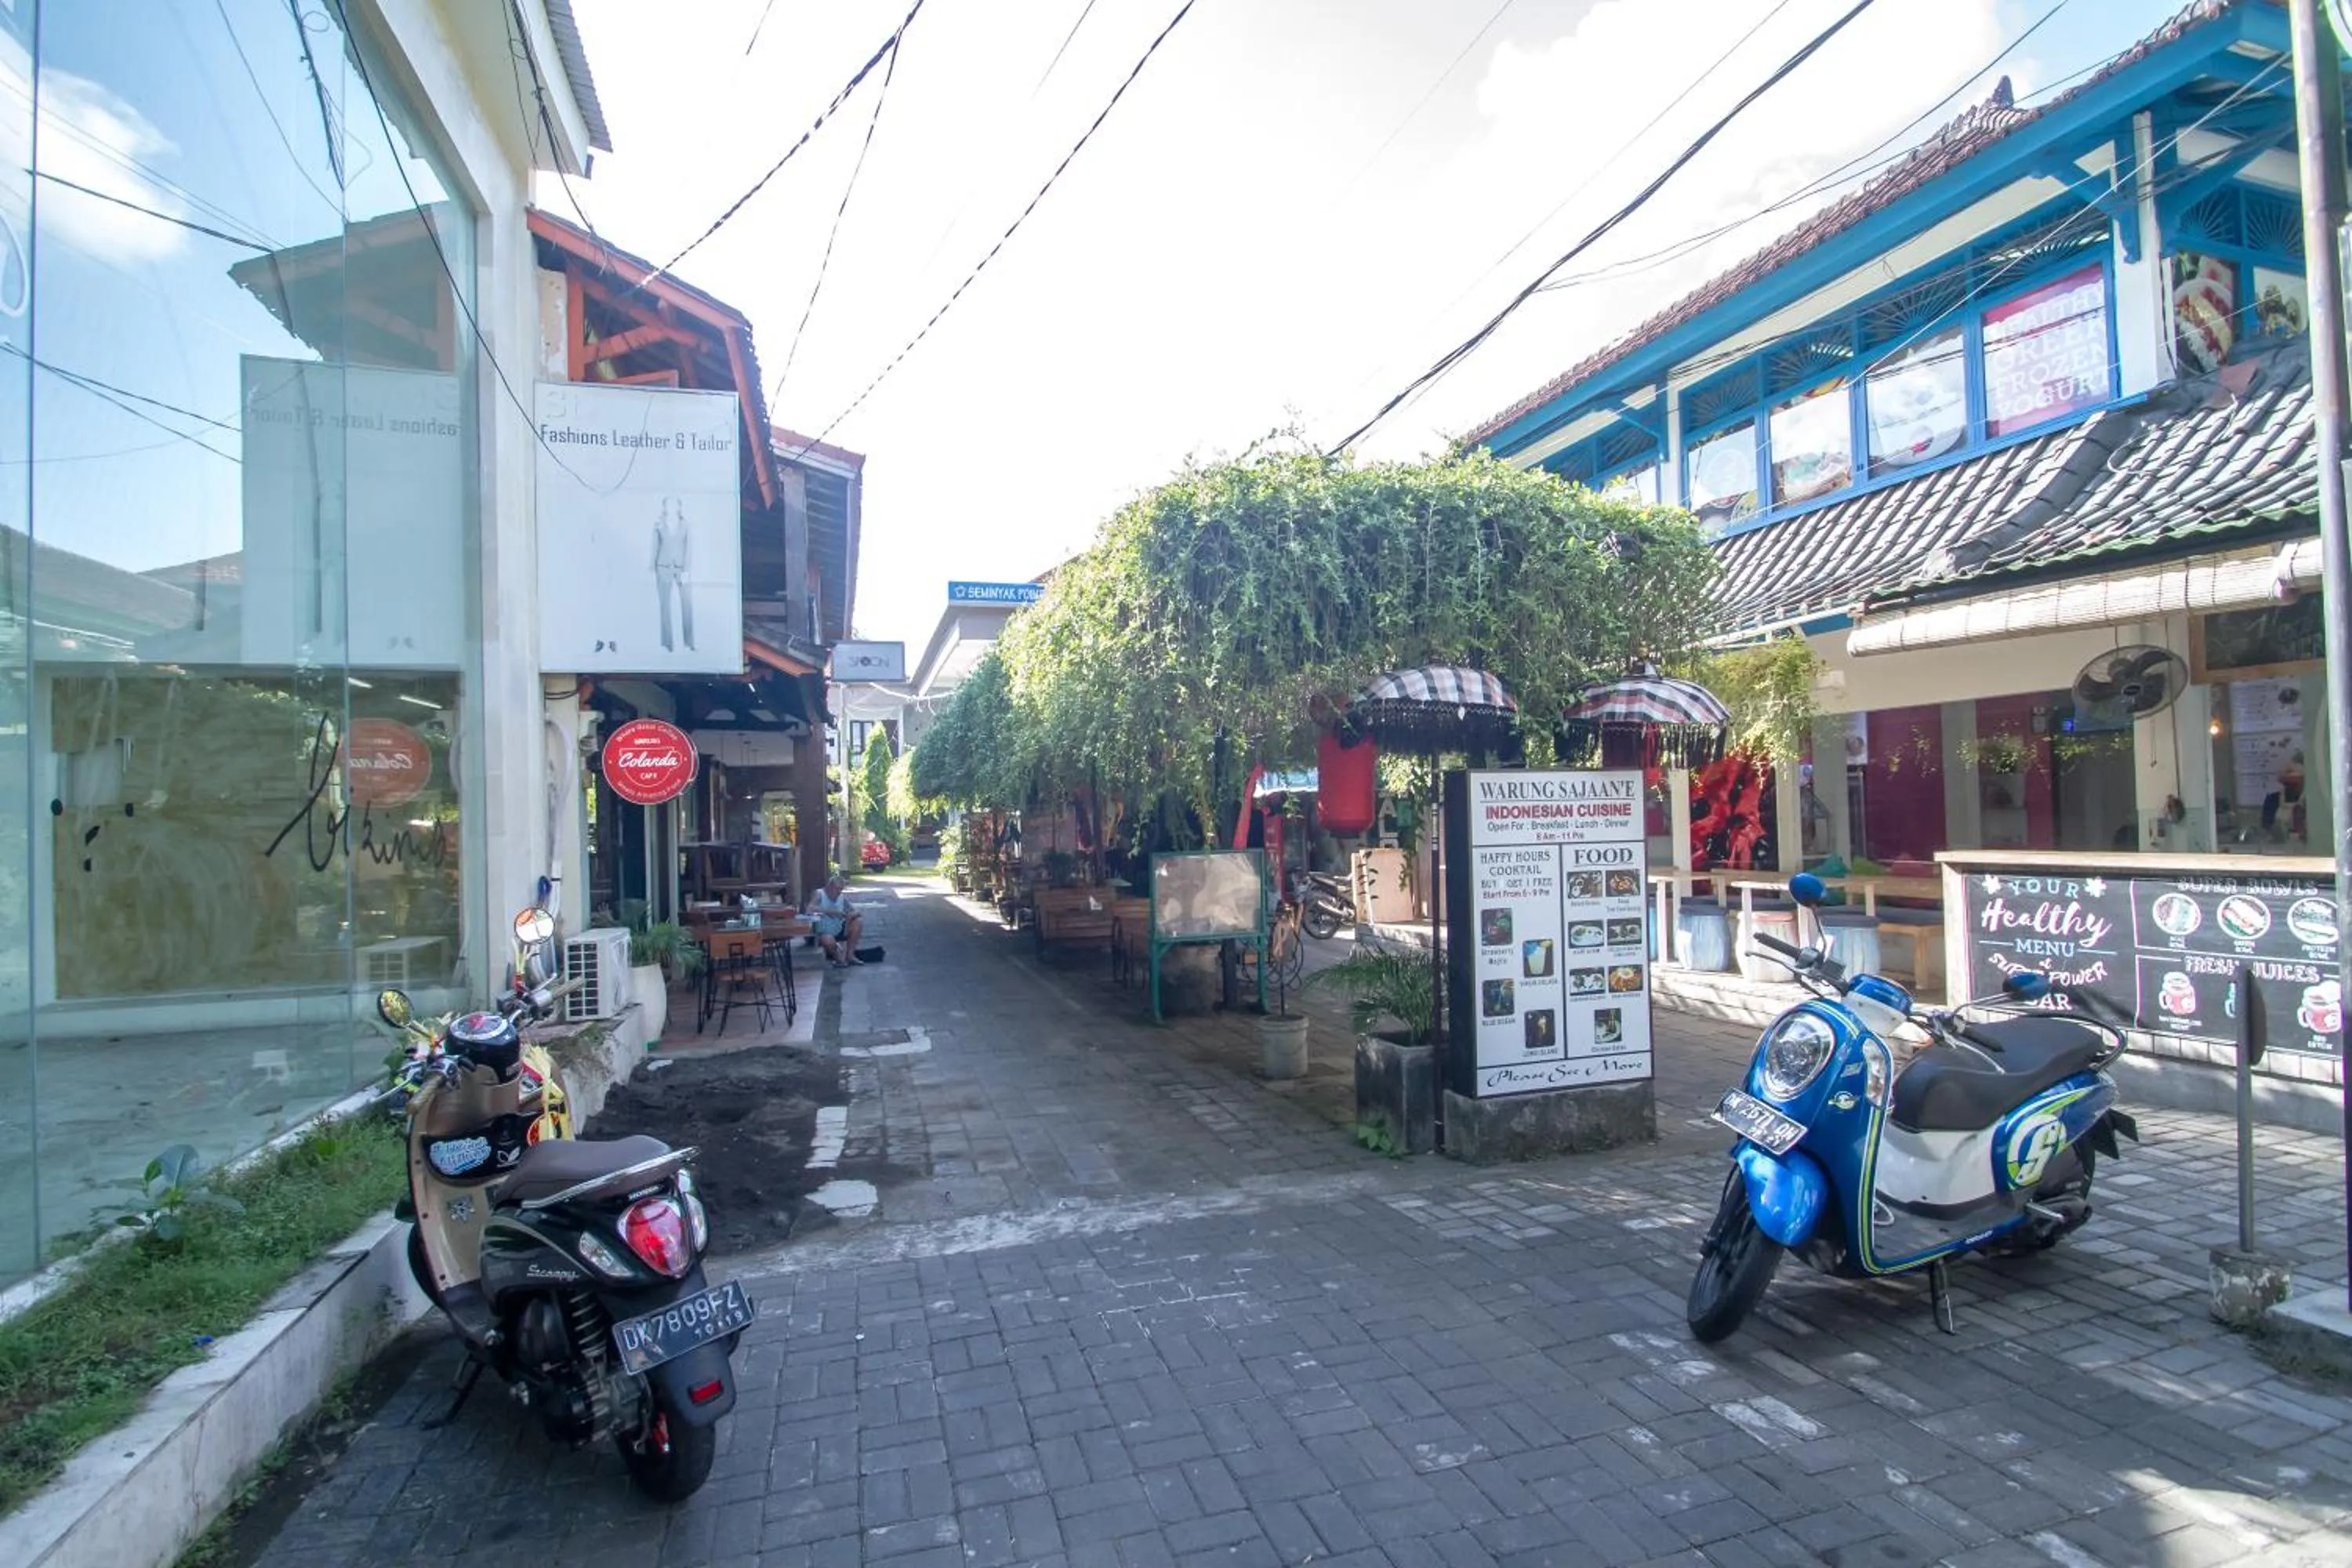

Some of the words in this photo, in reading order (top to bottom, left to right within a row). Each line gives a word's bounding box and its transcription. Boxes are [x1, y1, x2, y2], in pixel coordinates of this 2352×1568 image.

[539, 423, 608, 447] Fashions
[613, 429, 671, 450] Leather
[675, 432, 685, 450] &
[691, 433, 732, 452] Tailor
[968, 586, 1018, 600] SEMINYAK
[619, 751, 678, 768] Colanda
[1480, 781, 1555, 800] WARUNG
[1486, 804, 1573, 820] INDONESIAN
[1577, 803, 1632, 818] CUISINE
[1487, 822, 1509, 832] Open
[1531, 820, 1569, 830] Breakfast
[1574, 819, 1599, 829] Lunch
[1480, 852, 1512, 864] HAPPY
[1515, 851, 1551, 862] HOURS
[1573, 847, 1633, 864] FOOD
[2008, 878, 2080, 898] YOUR
[2177, 876, 2238, 894] SUPER
[1980, 898, 2113, 948] Healthy
[2014, 938, 2075, 957] MENU
[2049, 960, 2108, 987] POWER
[2024, 993, 2073, 1011] AR
[1486, 1069, 1545, 1087] Please
[1548, 1064, 1581, 1083] See
[526, 1264, 580, 1282] Scoopy
